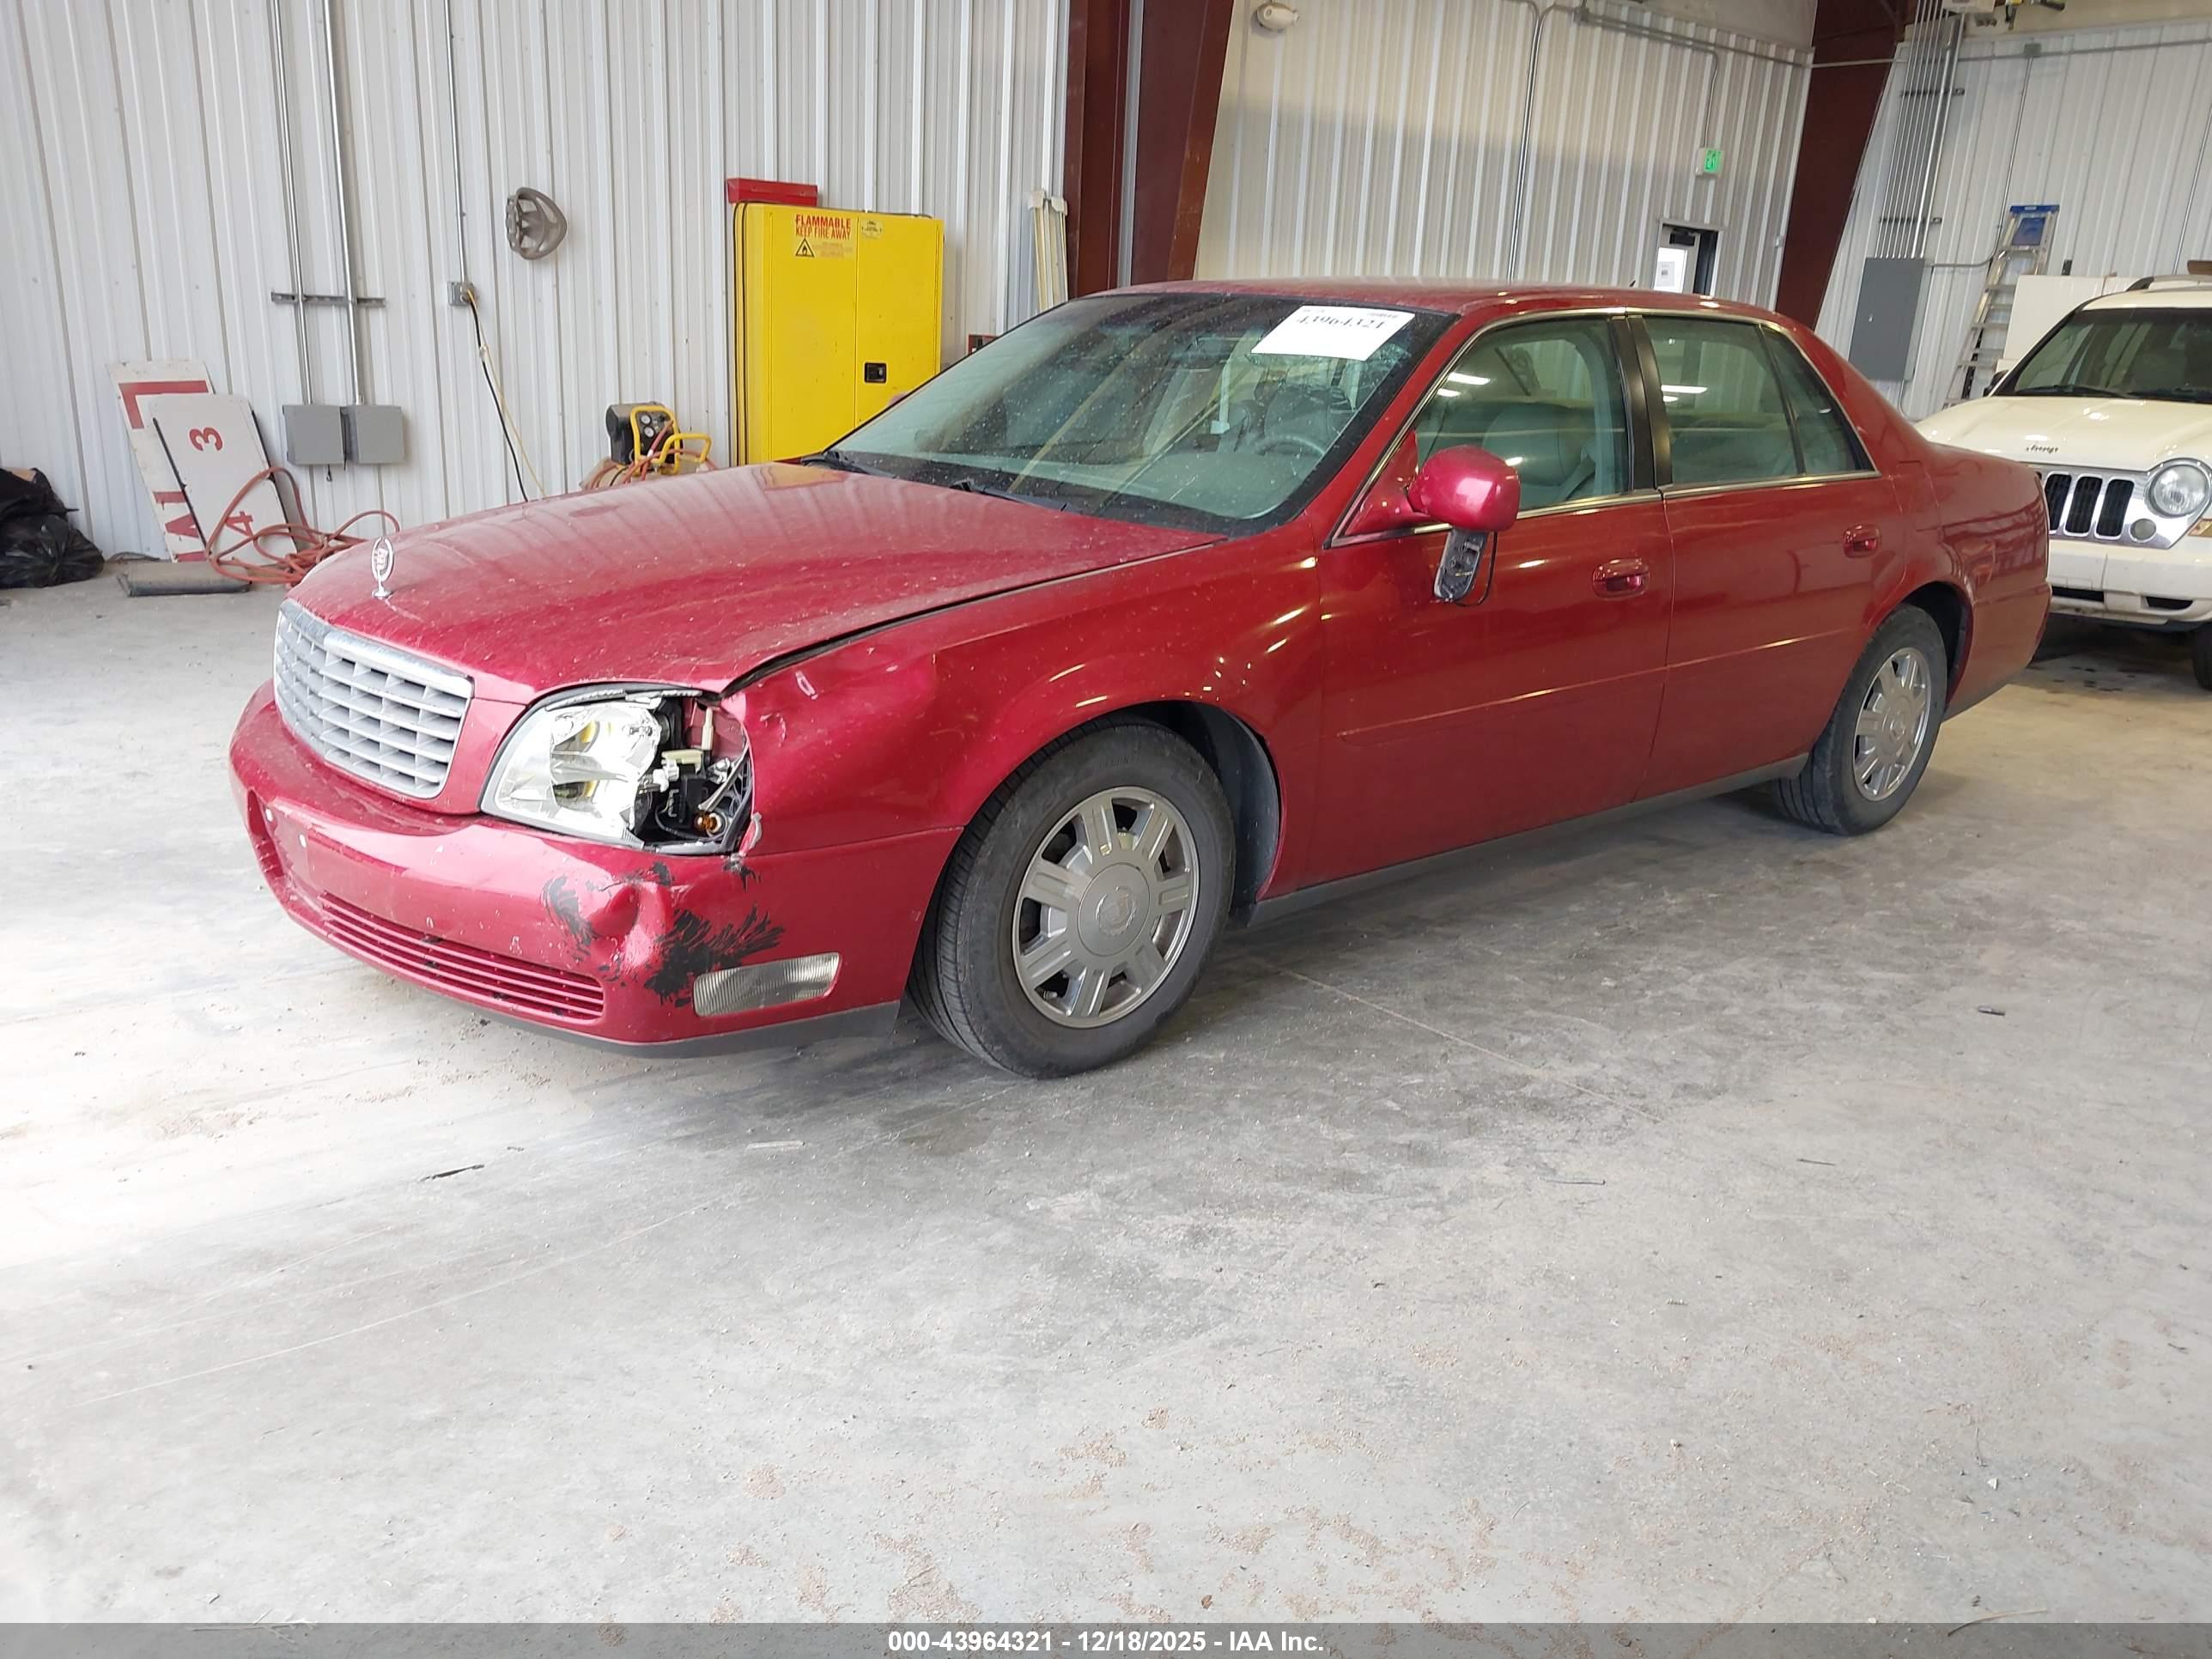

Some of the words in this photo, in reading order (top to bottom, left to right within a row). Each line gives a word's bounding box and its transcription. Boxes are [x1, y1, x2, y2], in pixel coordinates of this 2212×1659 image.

[795, 214, 851, 228] FLAMMABLE
[795, 224, 812, 238] KEEP
[814, 226, 830, 239] FIRE
[830, 227, 851, 240] AWAY
[188, 426, 224, 452] 3
[225, 510, 254, 538] 4
